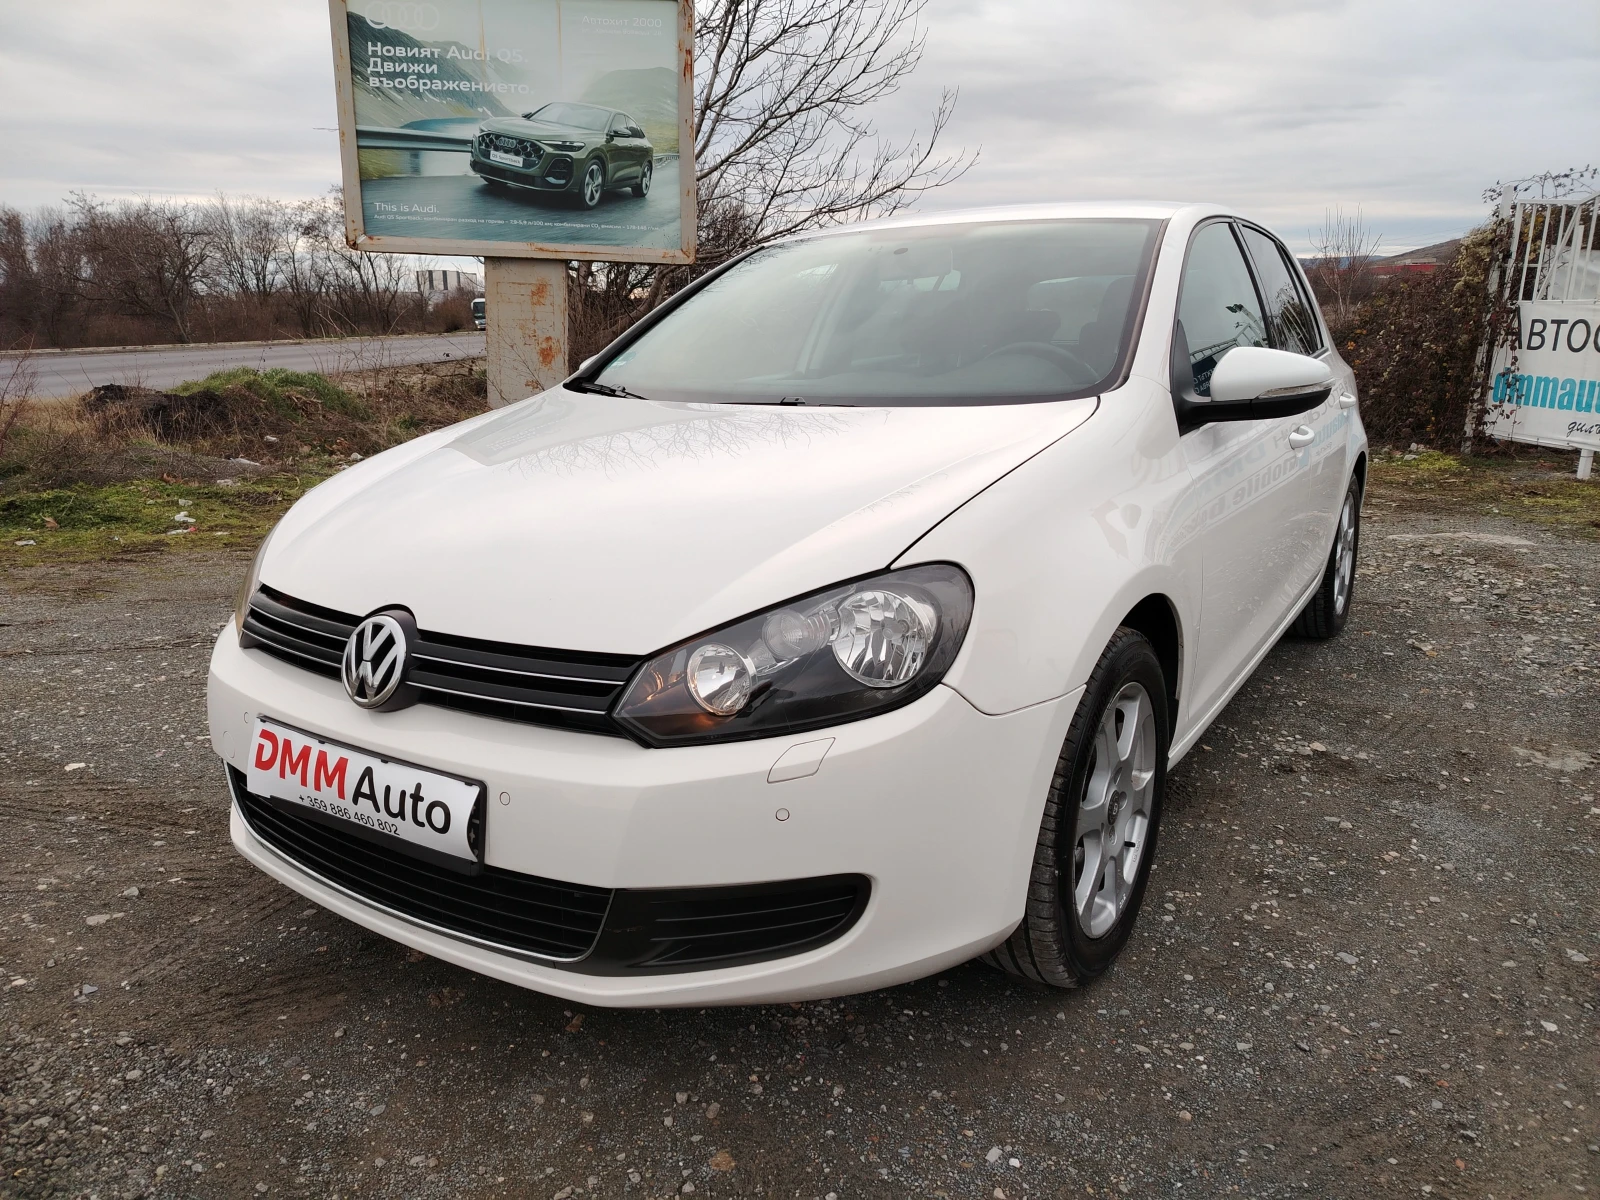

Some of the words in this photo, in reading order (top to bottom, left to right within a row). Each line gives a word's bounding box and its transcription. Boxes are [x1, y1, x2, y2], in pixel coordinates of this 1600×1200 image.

[581, 15, 629, 26] Автохит
[632, 17, 662, 28] 2000
[367, 41, 441, 58] Новият
[446, 45, 491, 61] Audi
[496, 48, 529, 63] Q5.
[367, 57, 438, 74] Движи
[369, 75, 535, 95] въображението.
[374, 202, 398, 212] This
[400, 203, 410, 212] is
[411, 204, 440, 213] Audi.
[1499, 303, 1600, 353] Авто
[306, 795, 328, 812] 359
[330, 802, 351, 820] 886
[353, 812, 375, 828] 460
[377, 819, 400, 836] 802
